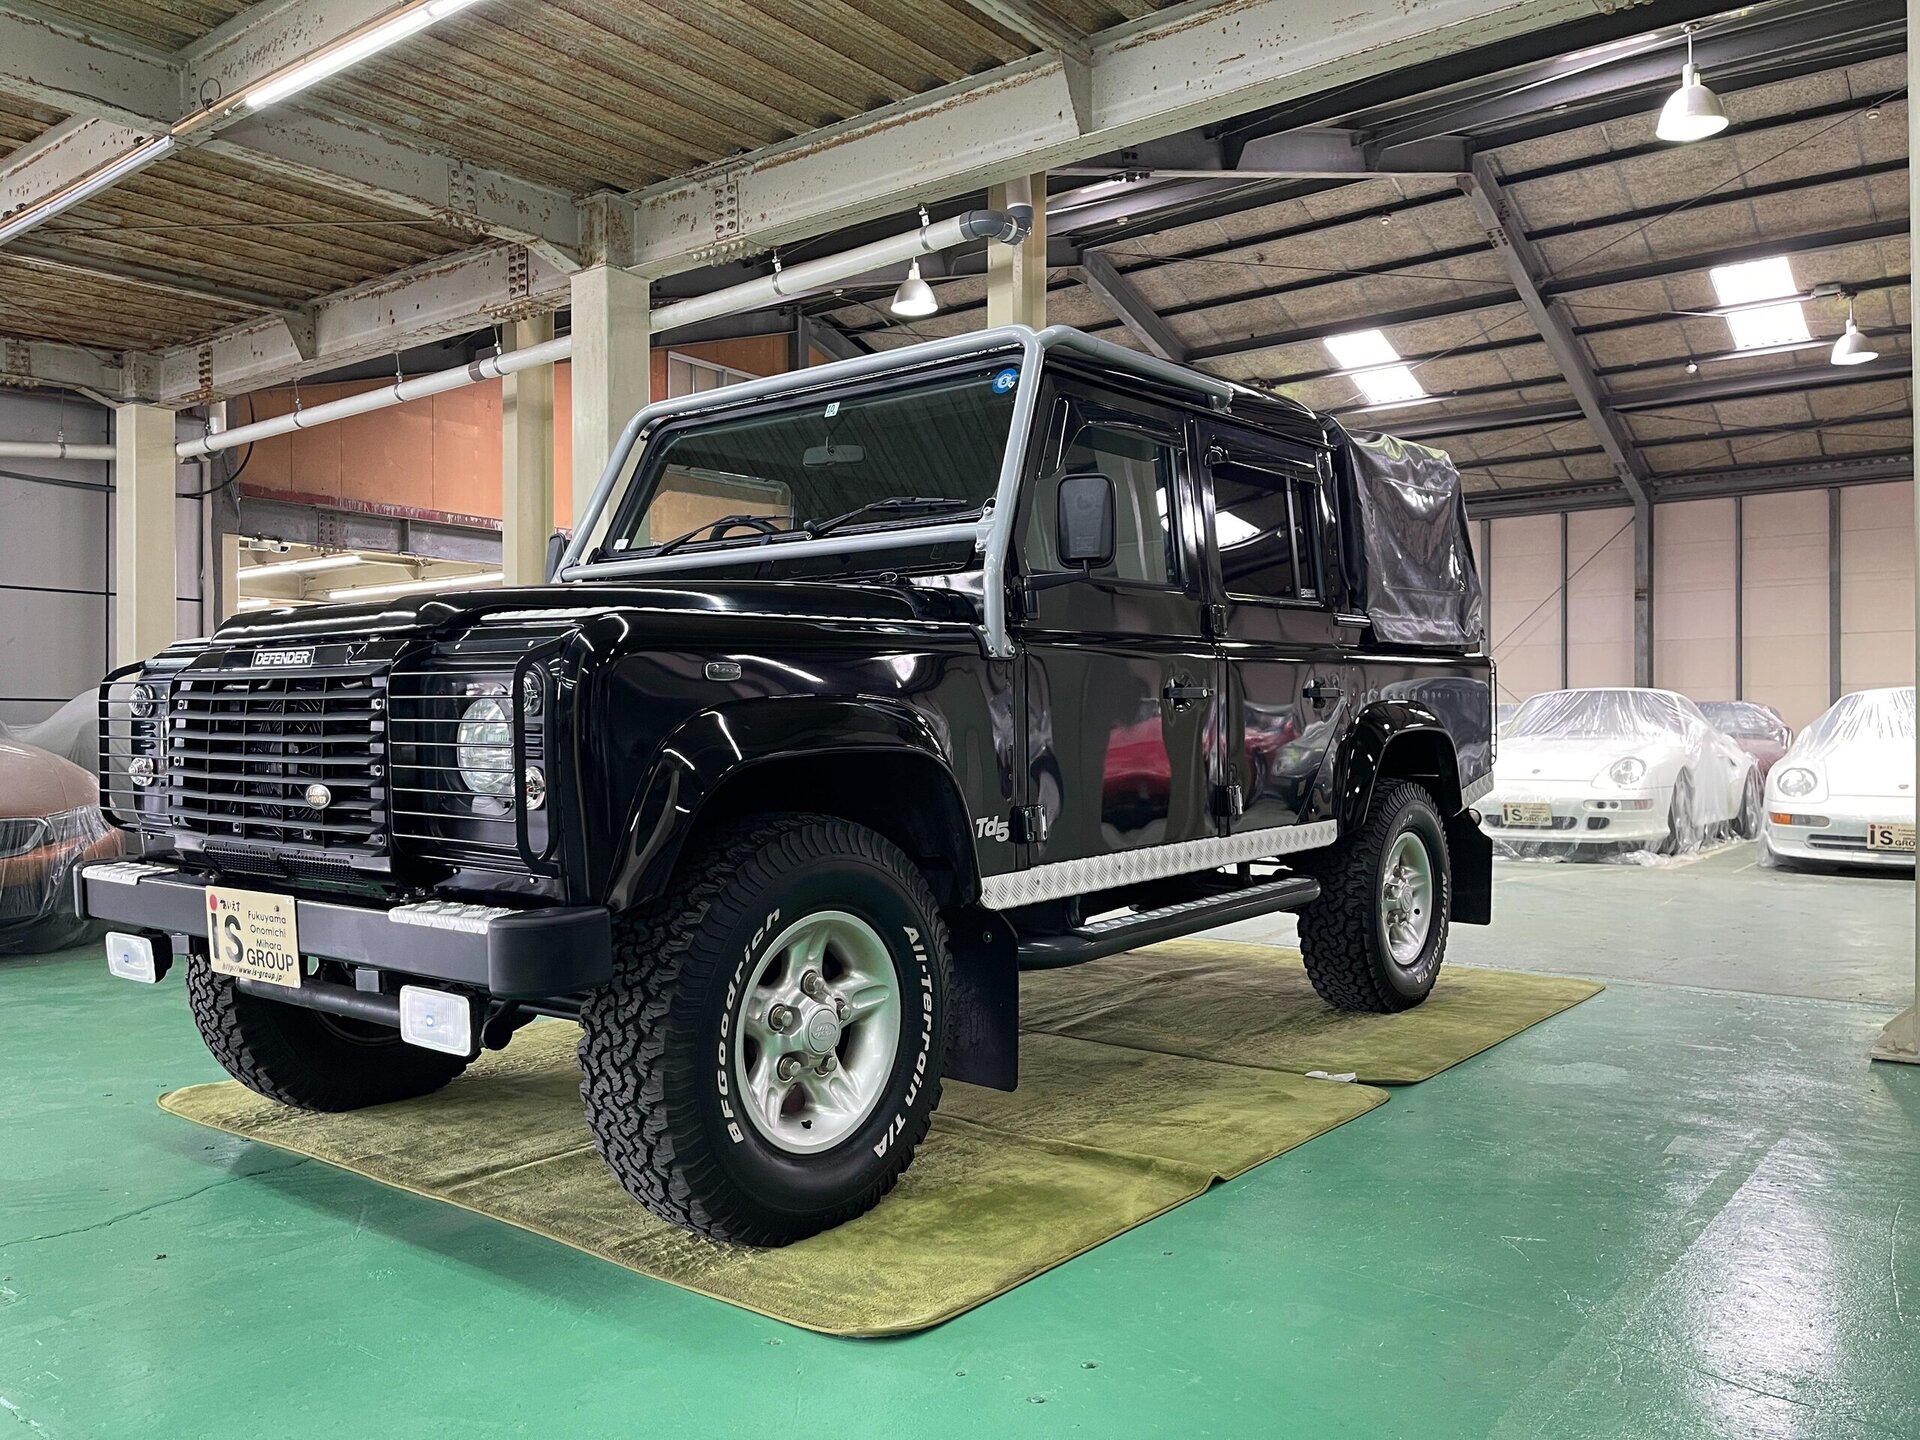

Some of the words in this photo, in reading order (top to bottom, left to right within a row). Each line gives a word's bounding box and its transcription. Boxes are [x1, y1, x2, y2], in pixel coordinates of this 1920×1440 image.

[254, 650, 311, 665] DEFENDER
[975, 815, 1010, 843] Td5
[247, 910, 287, 925] Fukuyama
[249, 924, 287, 938] Onomichi
[255, 938, 282, 951] Mihara
[246, 948, 294, 972] GROUP
[716, 907, 780, 1144] BFGoodrich
[902, 925, 933, 1107] All-Terrain
[872, 1112, 906, 1159] T/A
